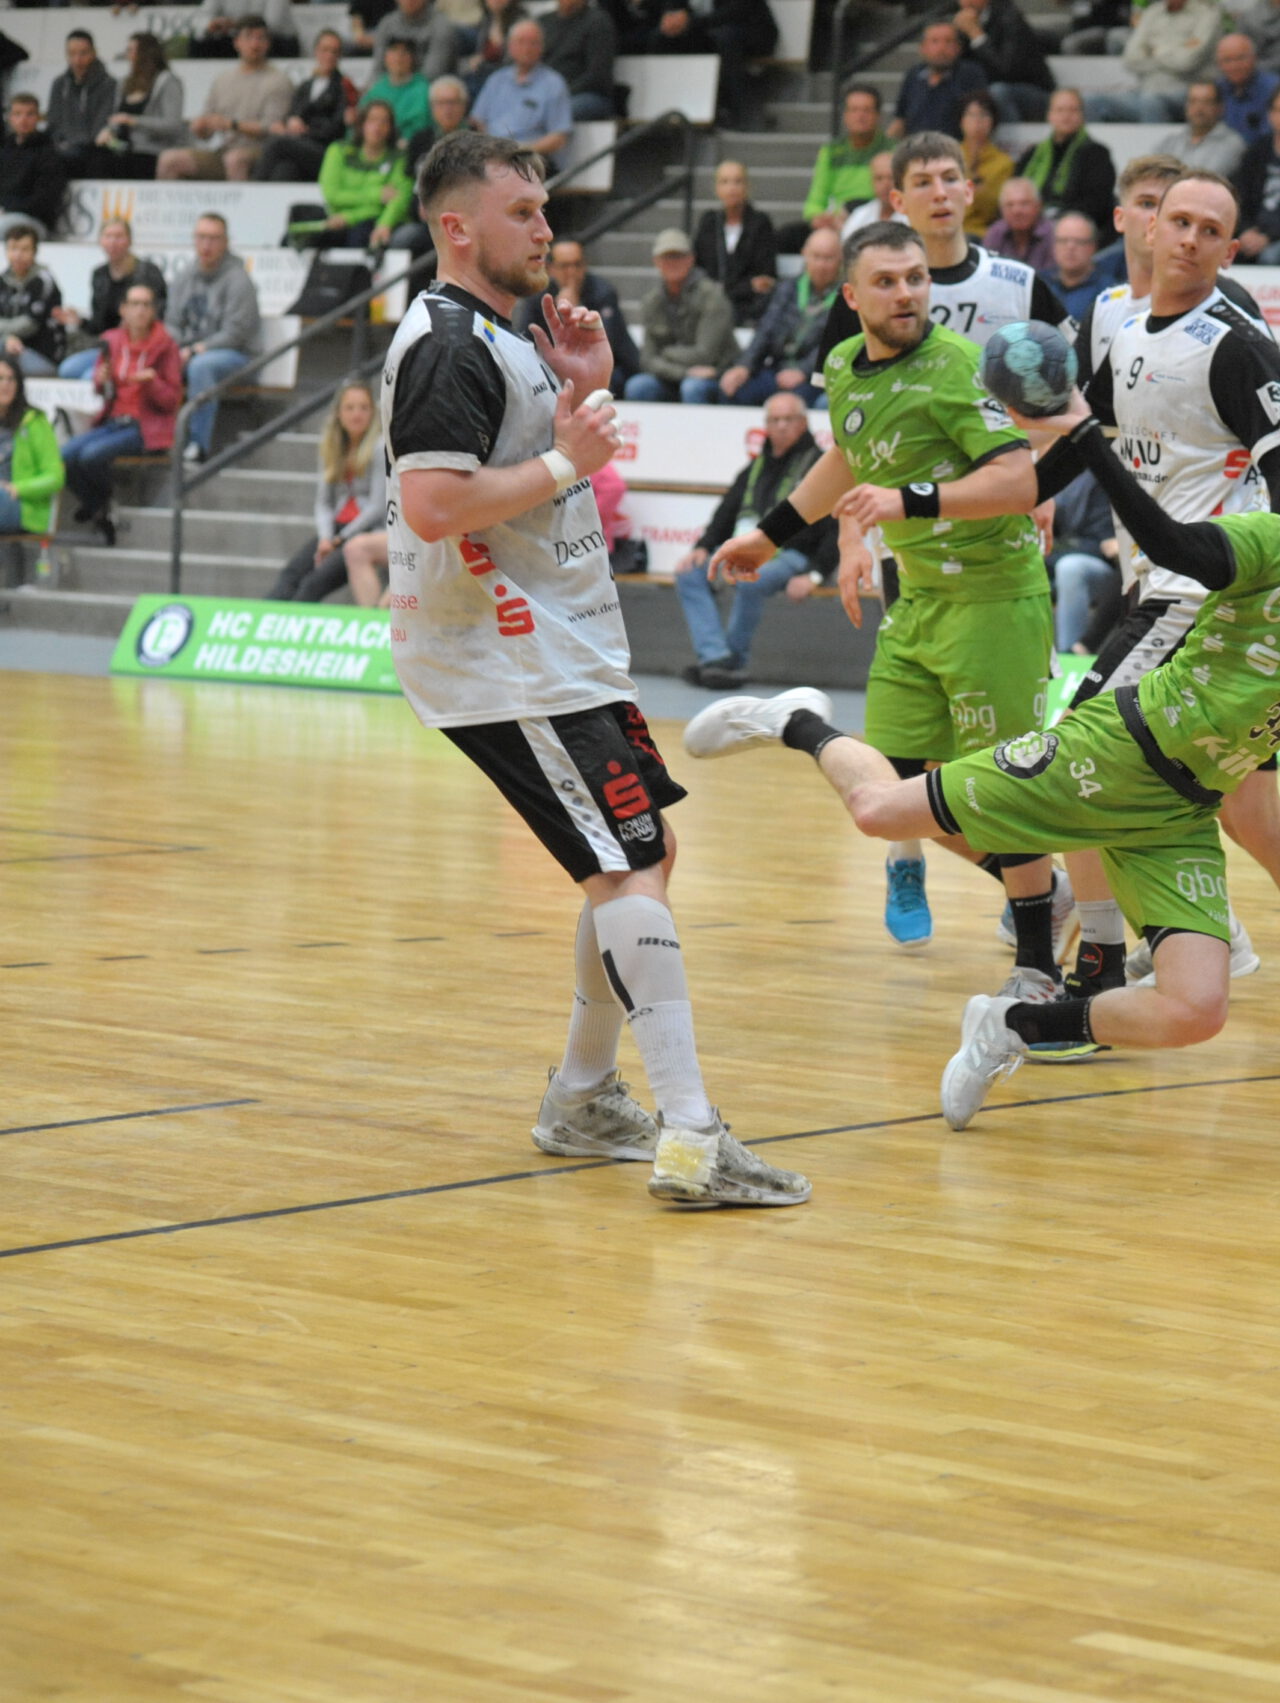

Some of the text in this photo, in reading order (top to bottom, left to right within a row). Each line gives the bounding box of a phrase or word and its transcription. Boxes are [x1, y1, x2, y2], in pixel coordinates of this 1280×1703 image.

[931, 302, 977, 333] 27
[1126, 356, 1144, 390] 9
[207, 611, 391, 649] HC EINTRACH
[193, 642, 370, 682] HILDESHEIM
[1069, 756, 1103, 799] 34
